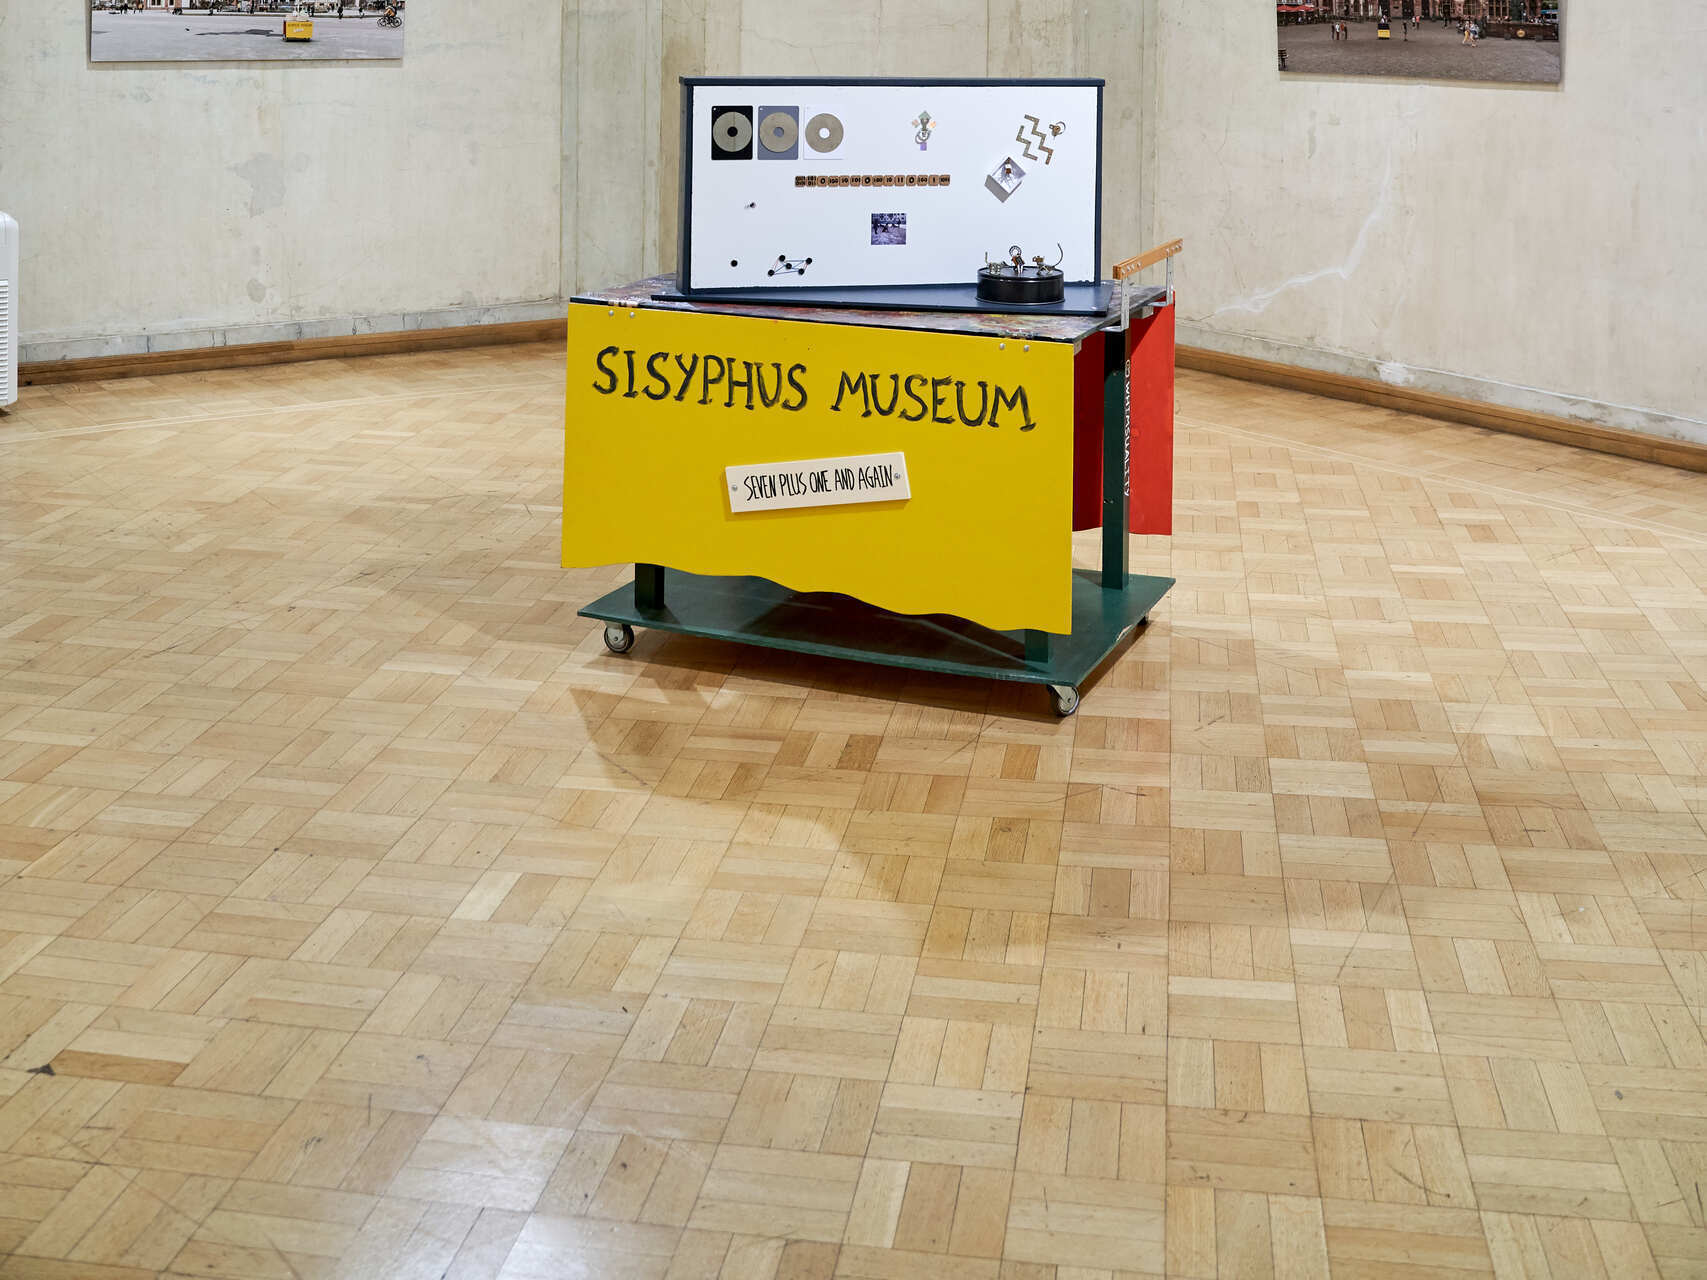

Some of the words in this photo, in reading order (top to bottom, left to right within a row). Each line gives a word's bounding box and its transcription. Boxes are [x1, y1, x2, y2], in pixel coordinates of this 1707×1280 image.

[593, 346, 807, 411] SISYPHUS
[831, 372, 1036, 430] MUSEUM
[744, 475, 776, 501] SEVEN
[779, 472, 807, 496] PLUS
[810, 470, 831, 492] ONE
[835, 468, 854, 490] AND
[859, 465, 893, 489] AGAIN
